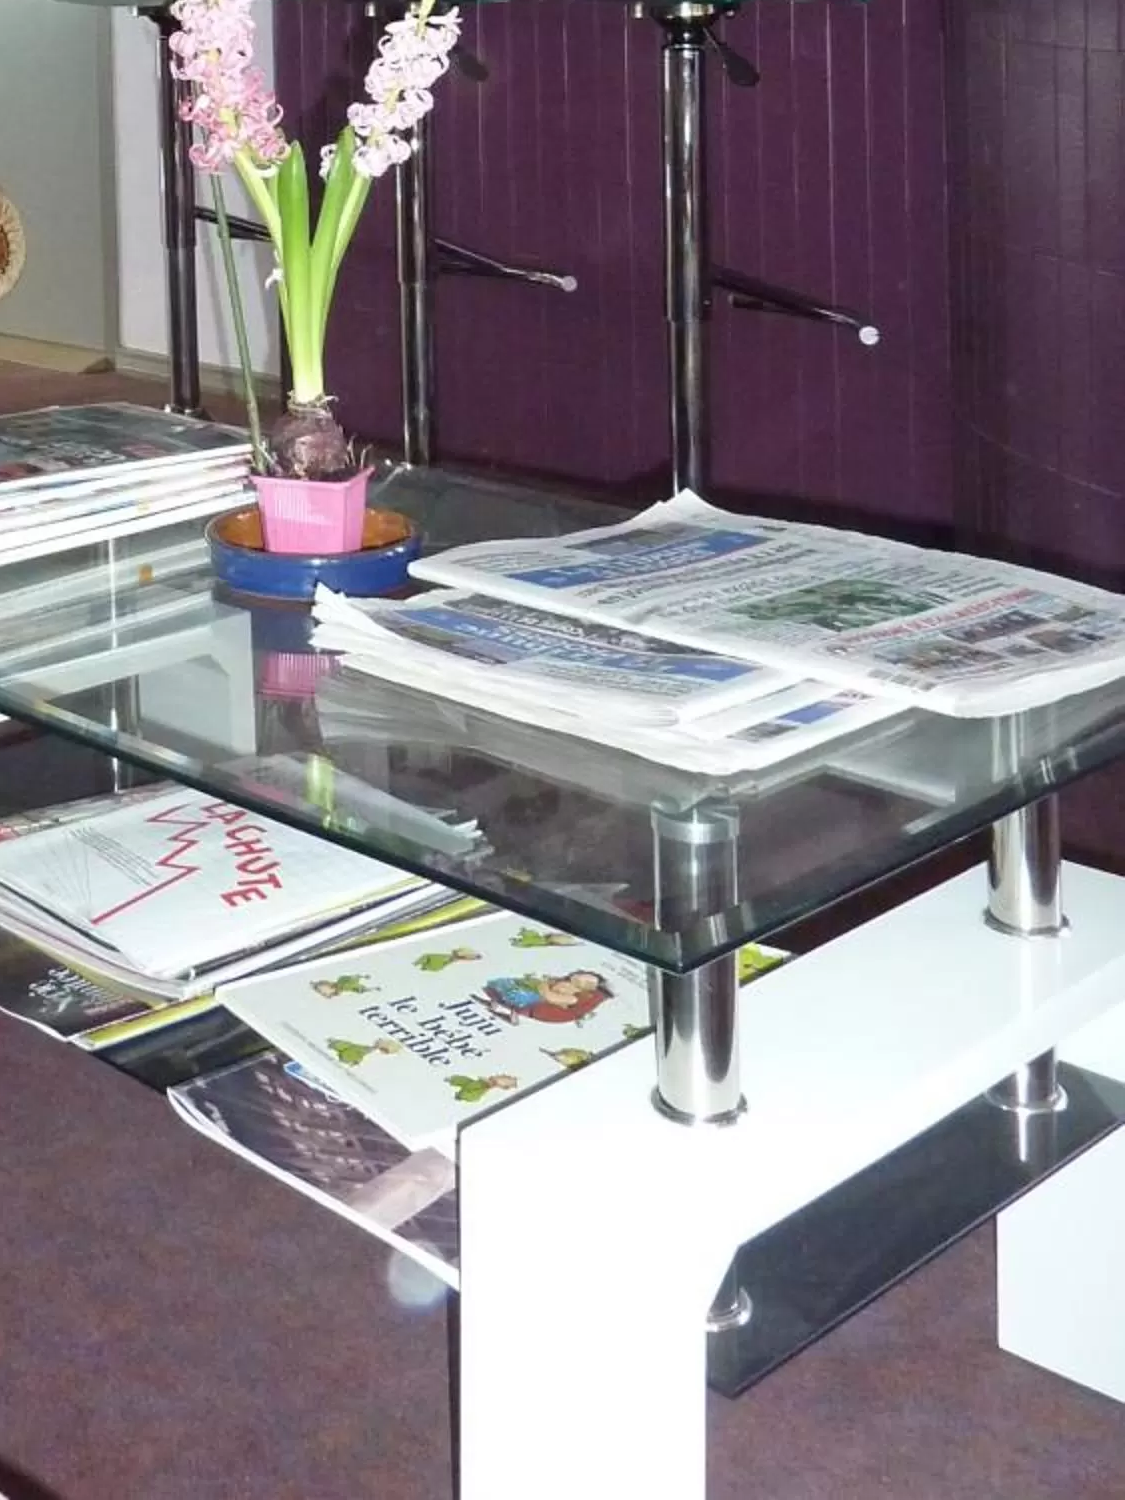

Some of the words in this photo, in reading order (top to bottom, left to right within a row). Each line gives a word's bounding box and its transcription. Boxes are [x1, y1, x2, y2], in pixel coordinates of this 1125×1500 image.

[200, 801, 248, 825] LA
[219, 824, 283, 908] CHUTE
[358, 1005, 452, 1066] terrible
[387, 995, 418, 1013] le
[418, 1014, 491, 1058] bébé
[438, 998, 503, 1037] Juju
